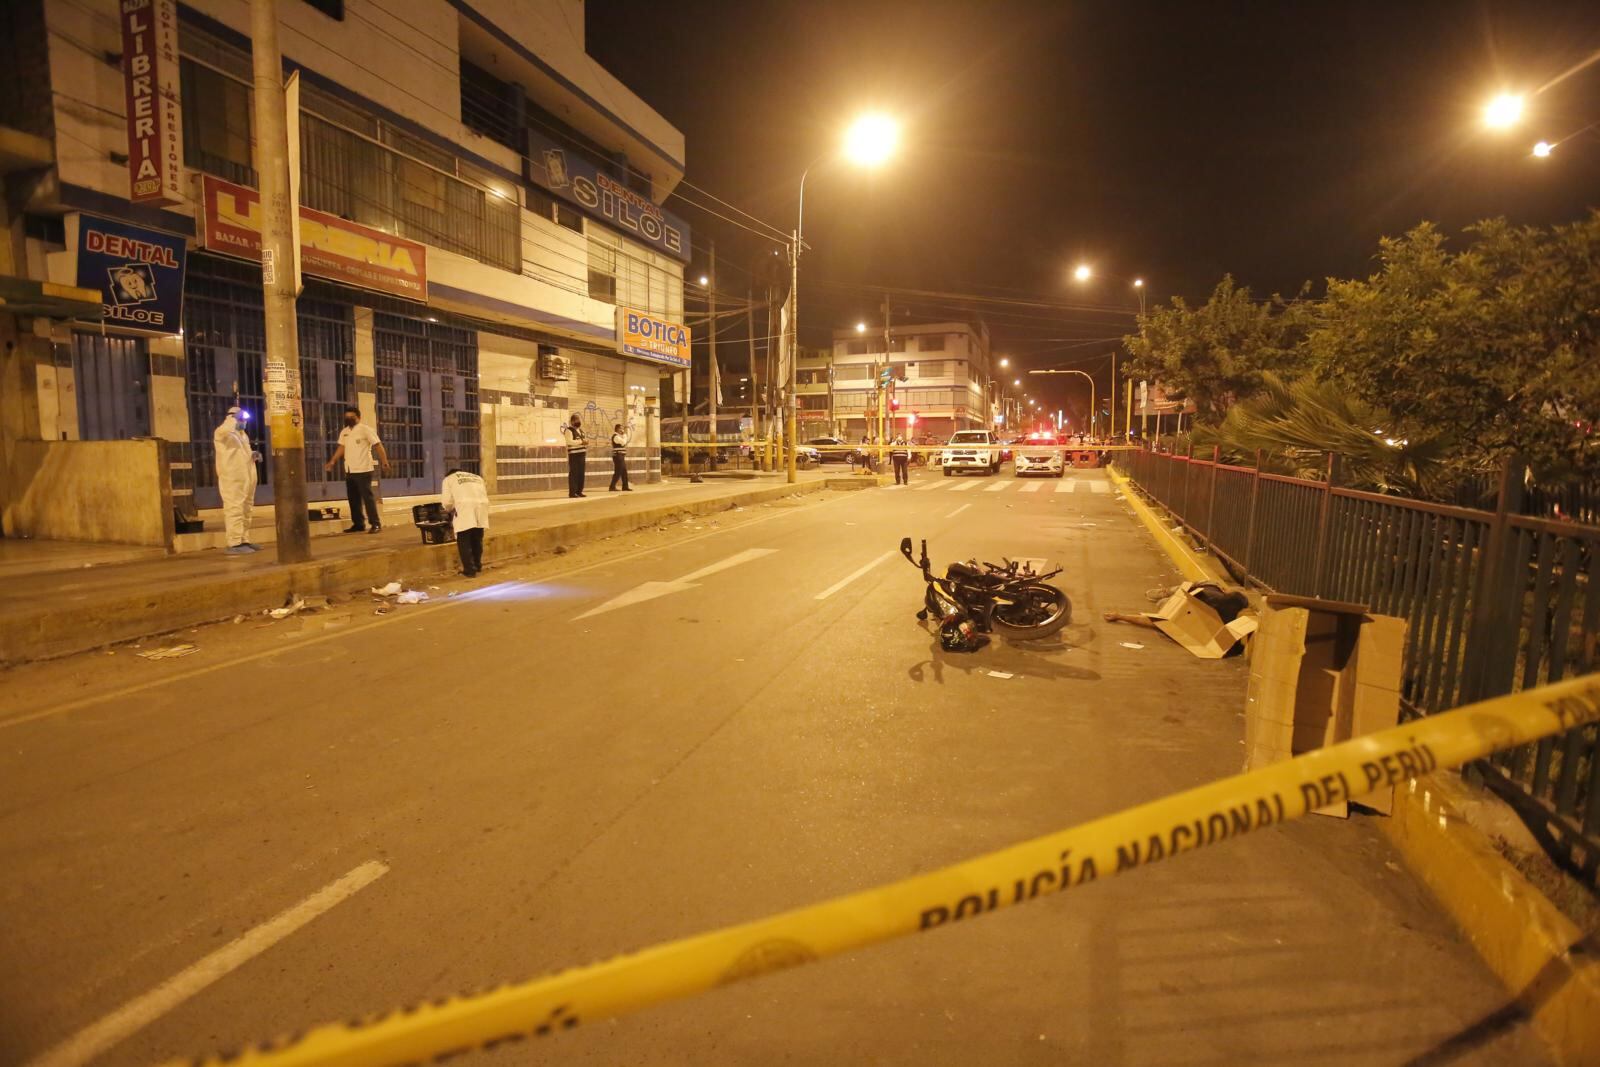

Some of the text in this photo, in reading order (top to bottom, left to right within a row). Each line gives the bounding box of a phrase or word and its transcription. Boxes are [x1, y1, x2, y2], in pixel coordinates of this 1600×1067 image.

[129, 14, 158, 181] LIBRERIA
[573, 176, 681, 253] SILOE
[597, 173, 664, 222] DENTAL
[86, 229, 178, 268] DENTAL
[215, 231, 249, 248] BAZAR
[102, 305, 164, 325] SILOE
[628, 313, 687, 347] BOTICA
[1114, 794, 1285, 872] NACIONAL
[1361, 736, 1438, 791] PERÚ
